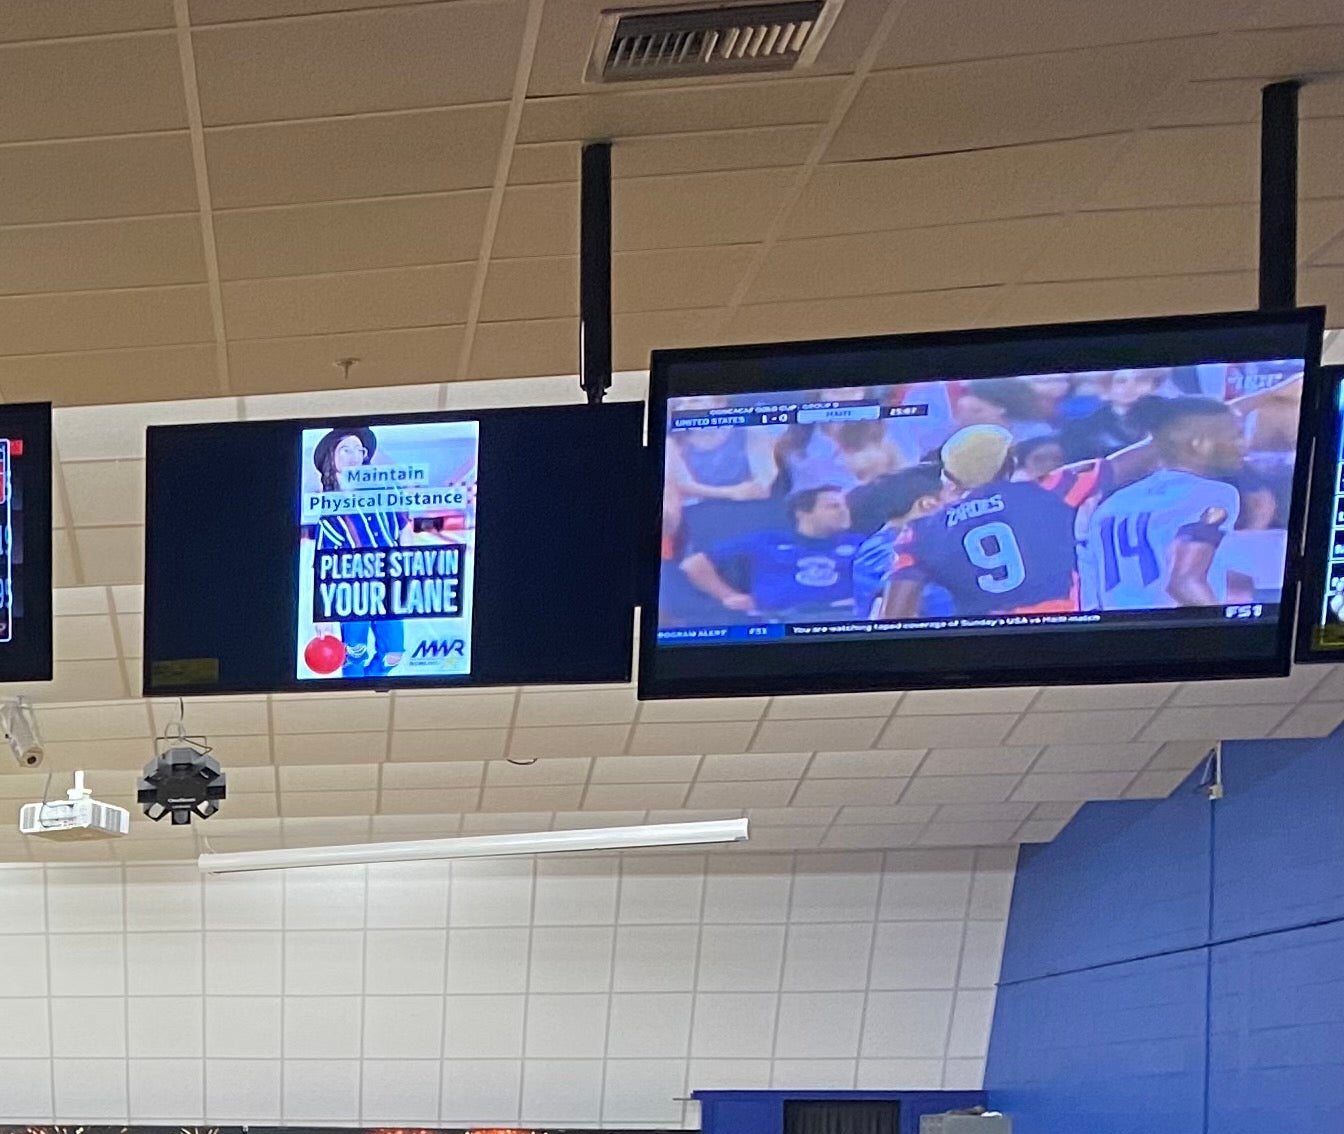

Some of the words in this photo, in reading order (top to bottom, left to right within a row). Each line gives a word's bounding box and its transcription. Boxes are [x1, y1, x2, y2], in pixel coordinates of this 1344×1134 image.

[347, 466, 425, 483] Maintain
[310, 494, 382, 512] Physical
[387, 492, 463, 506] Distance
[963, 521, 1026, 593] 9
[1100, 512, 1160, 592] 14
[320, 552, 386, 580] PLEASE
[319, 580, 387, 618] YOUR
[392, 578, 459, 614] LANE
[1225, 604, 1263, 619] FS1
[412, 639, 466, 658] MWR
